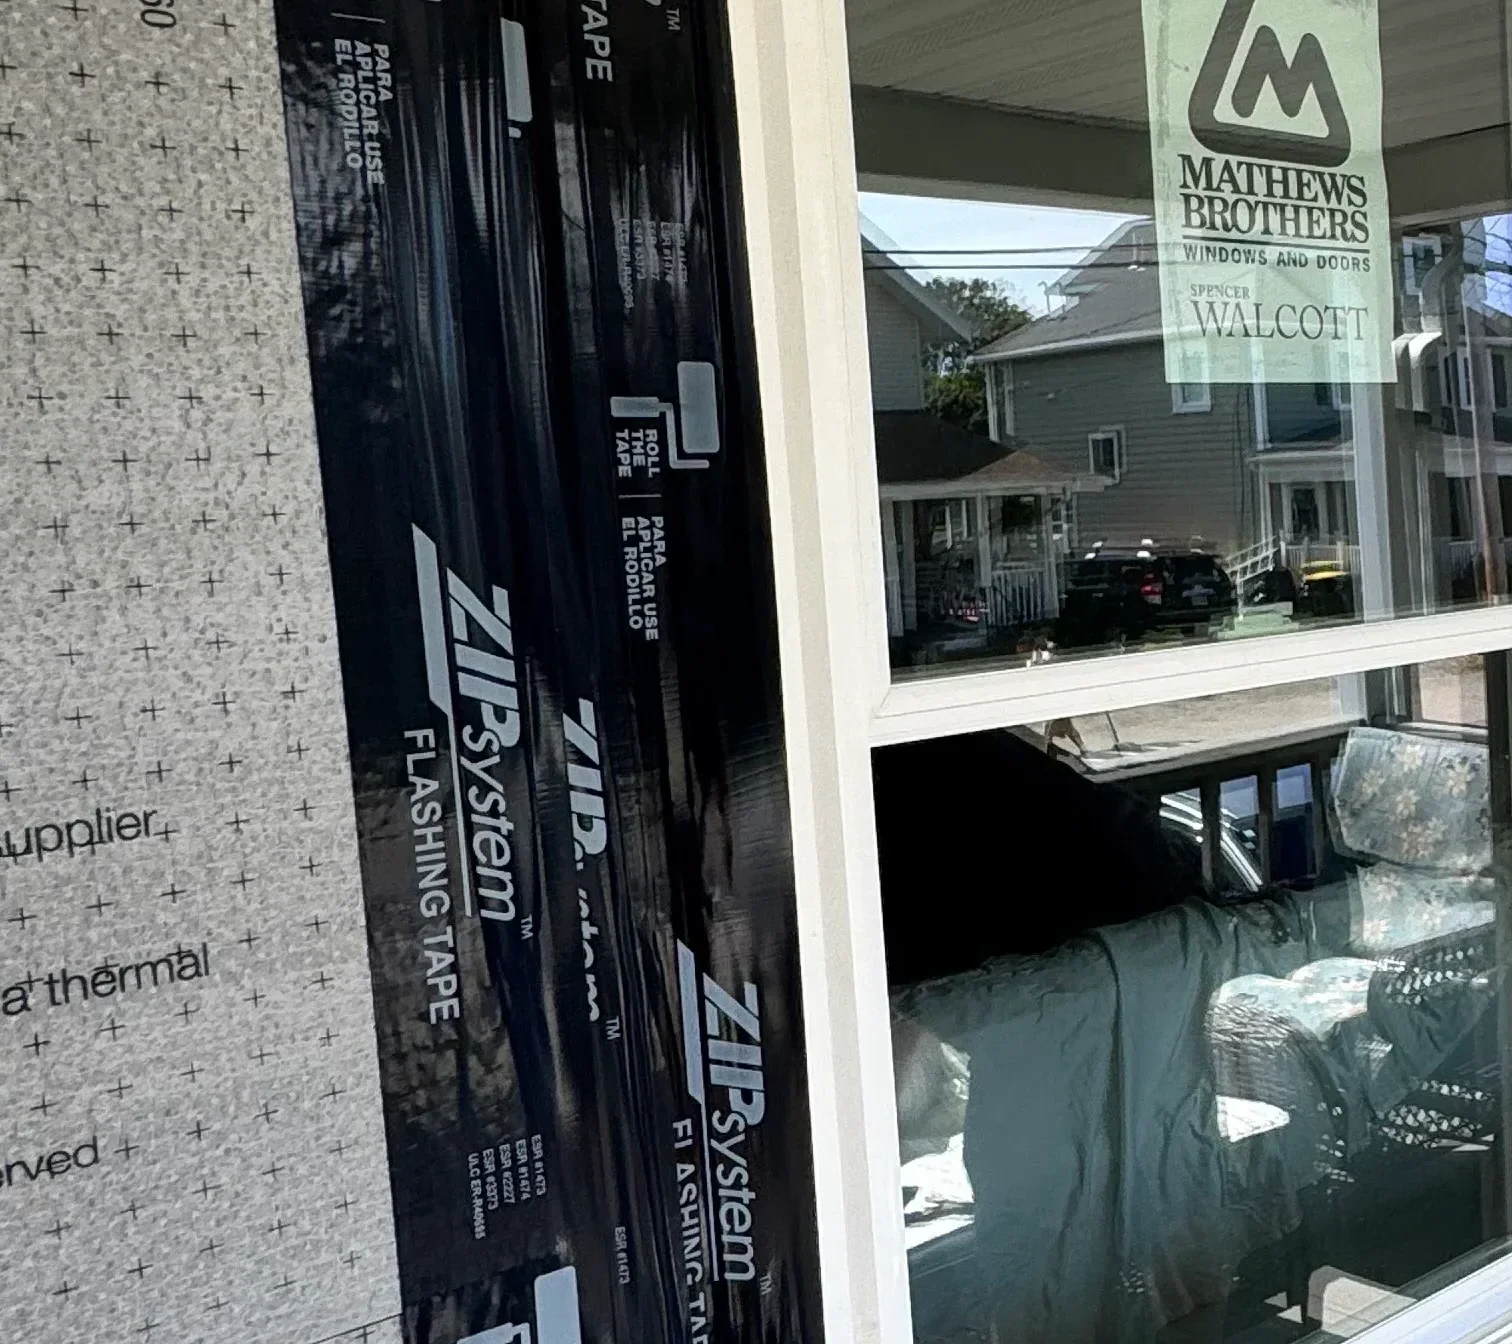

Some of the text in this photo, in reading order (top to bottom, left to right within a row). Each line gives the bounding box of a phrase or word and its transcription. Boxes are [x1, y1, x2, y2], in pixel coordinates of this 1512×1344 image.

[373, 42, 394, 102] PARA
[334, 38, 364, 169] EL RODILLO
[354, 39, 385, 185] APLICAR USE
[1177, 153, 1368, 208] MATHEWS
[1181, 192, 1370, 244] BROTHERS
[1183, 243, 1371, 273] WINDOWS AND DOORS
[1190, 283, 1251, 300] SPENCER
[1191, 300, 1369, 341] WALCOTT
[616, 429, 632, 478] TAPE
[630, 429, 646, 467] THE
[645, 429, 661, 478] ROLL
[651, 516, 667, 568] PARA
[621, 517, 643, 629] EL RODILLO
[636, 516, 659, 640] APLICAR USE
[403, 728, 461, 1026] FLASHING TAPE
[1, 941, 211, 1016] a thermal
